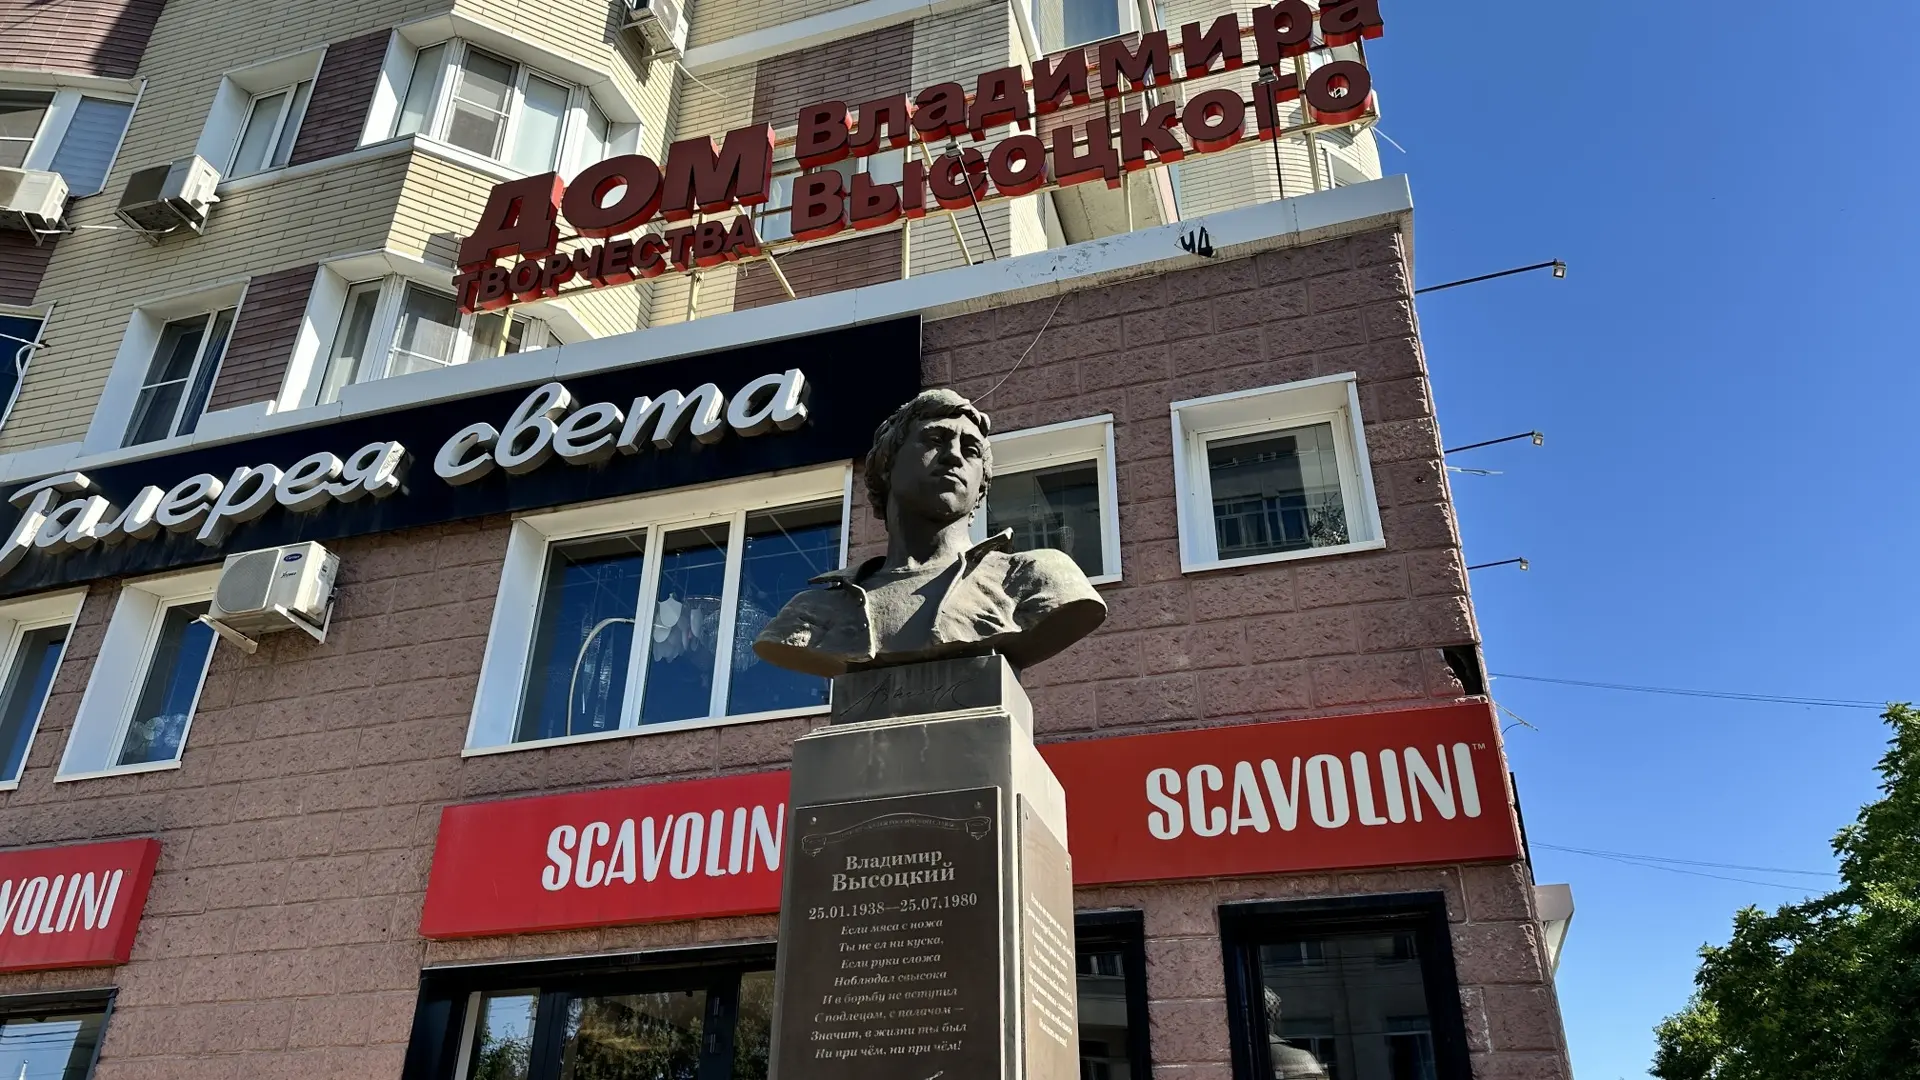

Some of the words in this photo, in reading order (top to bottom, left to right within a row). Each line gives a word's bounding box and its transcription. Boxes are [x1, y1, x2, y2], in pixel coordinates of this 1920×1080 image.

[794, 0, 1385, 168] Владимира
[790, 60, 1373, 242] Высоцкого
[457, 122, 775, 272] ДОМ
[452, 214, 762, 315] ТВОРЧЕСТВА
[0, 440, 406, 577] Галерея
[433, 367, 809, 487] света
[1145, 741, 1483, 841] SCAVOLINI
[541, 802, 785, 892] SCAVOLIN
[846, 850, 942, 870] Владимир
[832, 862, 956, 892] Высоцкий
[0, 868, 124, 936] VOLINI
[840, 925, 868, 935] Если
[870, 922, 899, 933] мяса
[901, 922, 907, 930] с
[910, 919, 943, 930] ножа
[838, 943, 855, 952] Ты
[858, 942, 872, 951] не
[874, 940, 888, 950] ел
[890, 939, 904, 949] ни
[907, 936, 945, 949] куска,
[841, 959, 869, 969] Если
[870, 957, 900, 969] руки
[902, 953, 941, 964] сложа
[834, 973, 895, 987] Наблюдал
[897, 970, 947, 982] свысока
[822, 995, 833, 1005] И
[834, 995, 842, 1004] в
[844, 991, 885, 1005] борьбу
[887, 991, 902, 1000] не
[904, 987, 958, 999] вступил
[814, 1013, 824, 1023] С
[889, 1010, 896, 1018] с
[898, 1006, 951, 1017] палачом
[810, 1029, 862, 1041] Значит,
[864, 1028, 872, 1038] в
[873, 1026, 915, 1037] жизни
[917, 1024, 939, 1034] ты
[941, 1022, 967, 1032] был
[815, 1048, 833, 1059] Ни
[835, 1049, 857, 1060] при
[889, 1045, 905, 1055] ни
[908, 1044, 931, 1056] при
[933, 1040, 963, 1052] чём!
